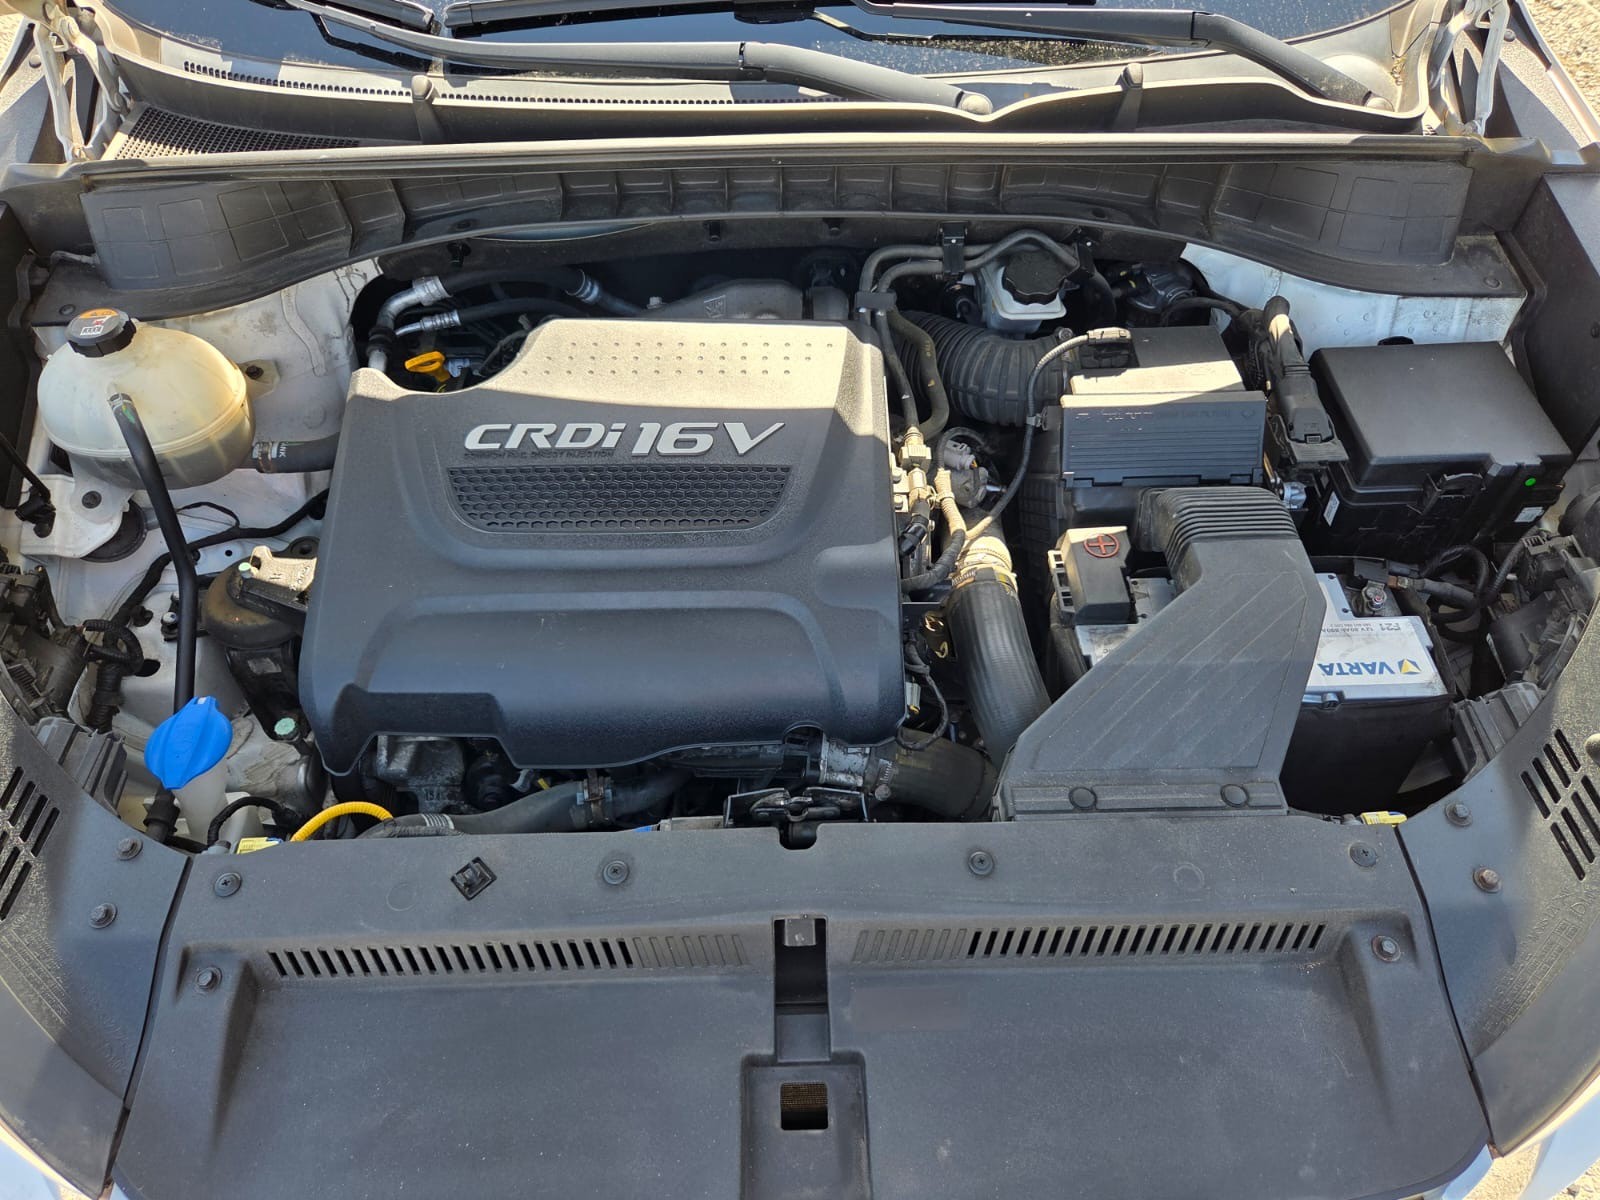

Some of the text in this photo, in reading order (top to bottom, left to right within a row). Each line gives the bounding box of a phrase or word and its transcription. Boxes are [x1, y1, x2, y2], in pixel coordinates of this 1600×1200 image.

[464, 423, 626, 449] CRDi
[1379, 622, 1401, 631] F21
[1317, 661, 1396, 676] VARTA
